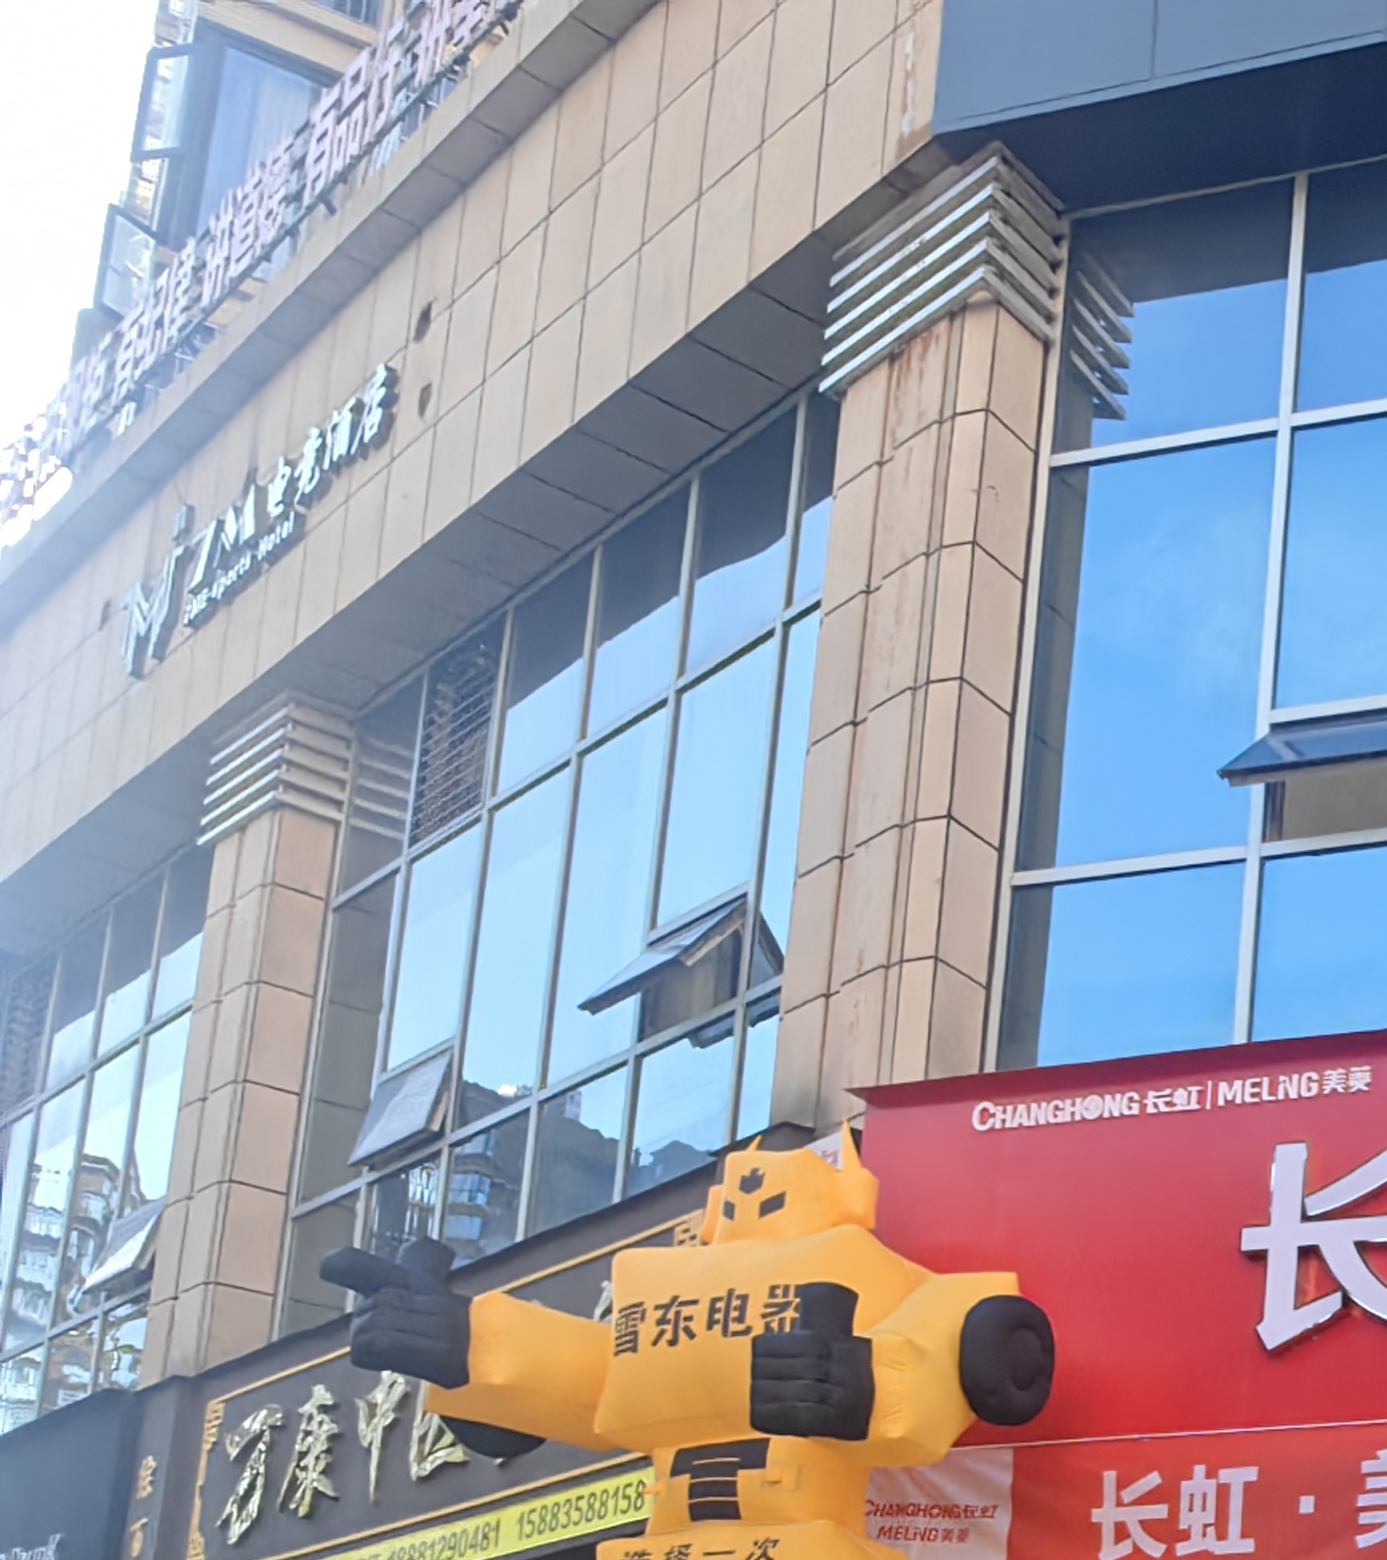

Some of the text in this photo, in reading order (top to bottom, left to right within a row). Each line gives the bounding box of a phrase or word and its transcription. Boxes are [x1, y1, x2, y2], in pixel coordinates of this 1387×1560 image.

[1143, 1086, 1202, 1115] 长虹
[1322, 1066, 1372, 1095] 美菱
[516, 1479, 647, 1542] 15883588158
